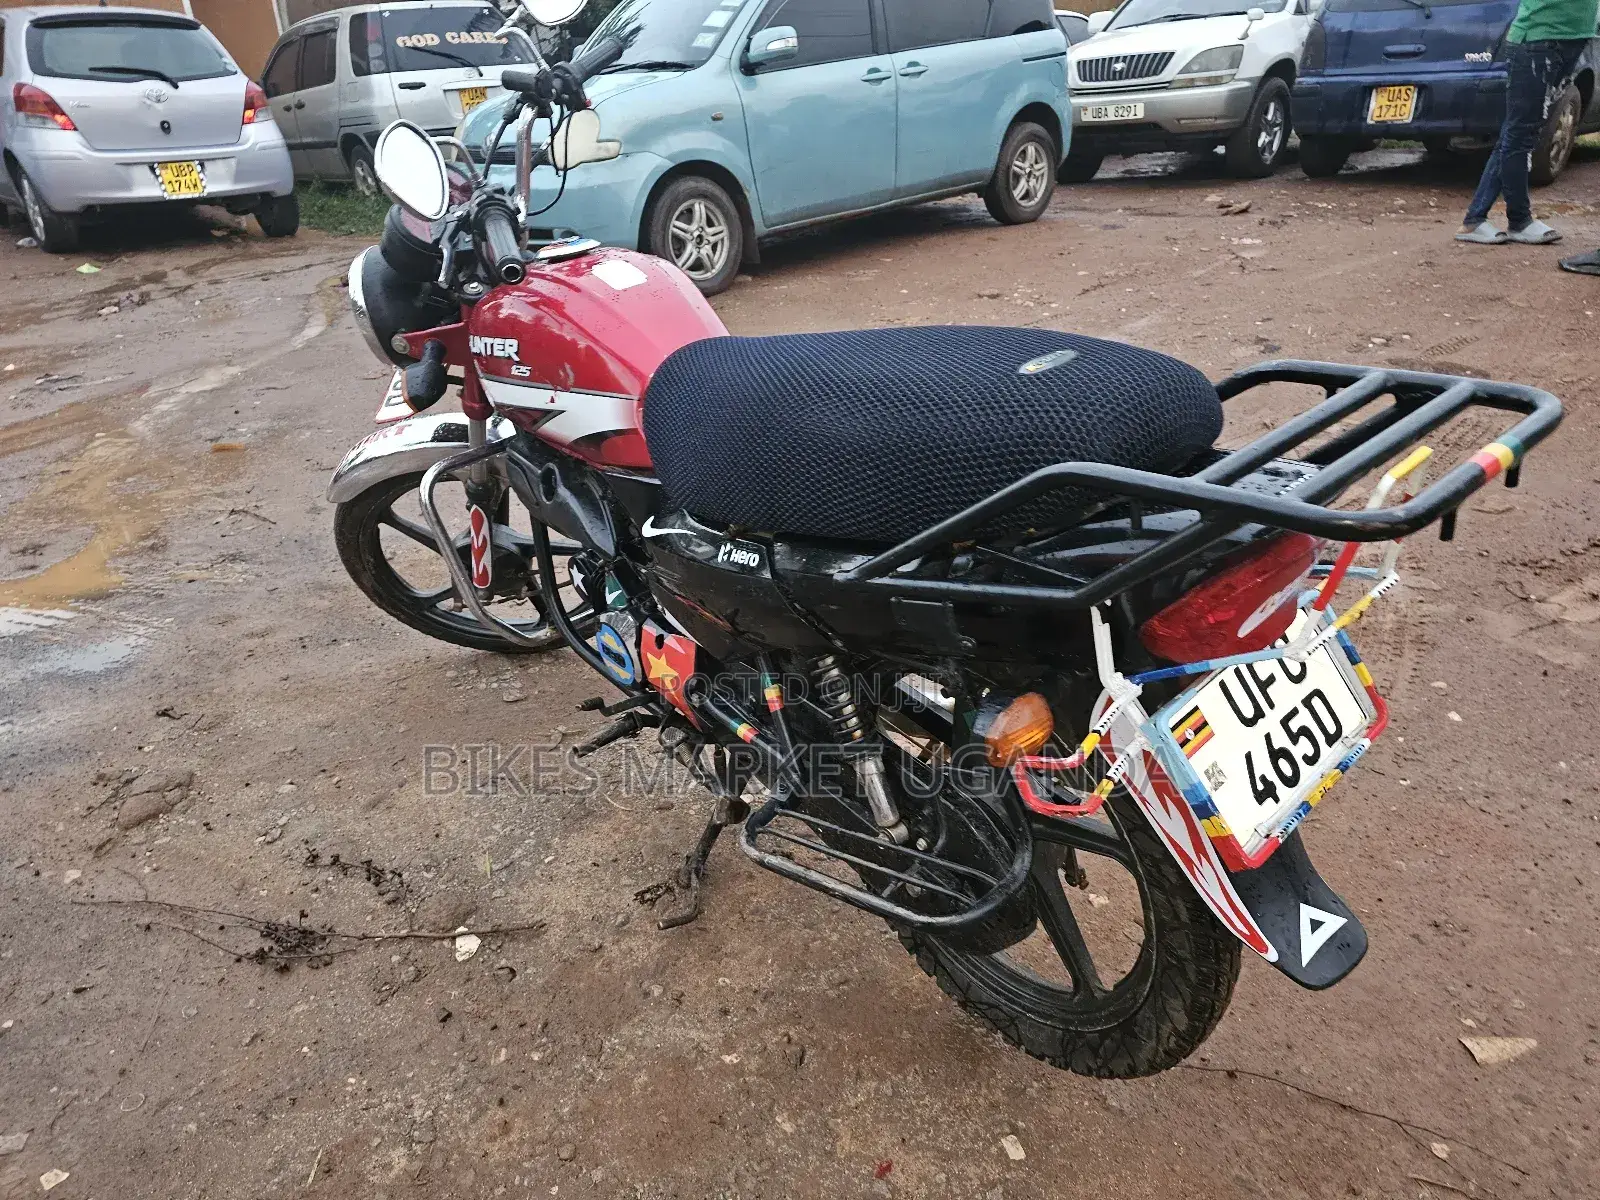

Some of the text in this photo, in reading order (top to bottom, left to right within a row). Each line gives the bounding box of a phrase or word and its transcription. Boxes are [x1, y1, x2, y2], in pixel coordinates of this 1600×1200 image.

[396, 31, 508, 47] GOD CARE
[1387, 88, 1412, 102] UAS
[1092, 106, 1109, 119] UBA
[1375, 104, 1406, 118] 171C
[168, 164, 195, 178] UBP
[168, 179, 199, 193] 174W
[469, 335, 520, 361] UNTER
[511, 365, 532, 377] 125
[1244, 688, 1343, 806] 465D
